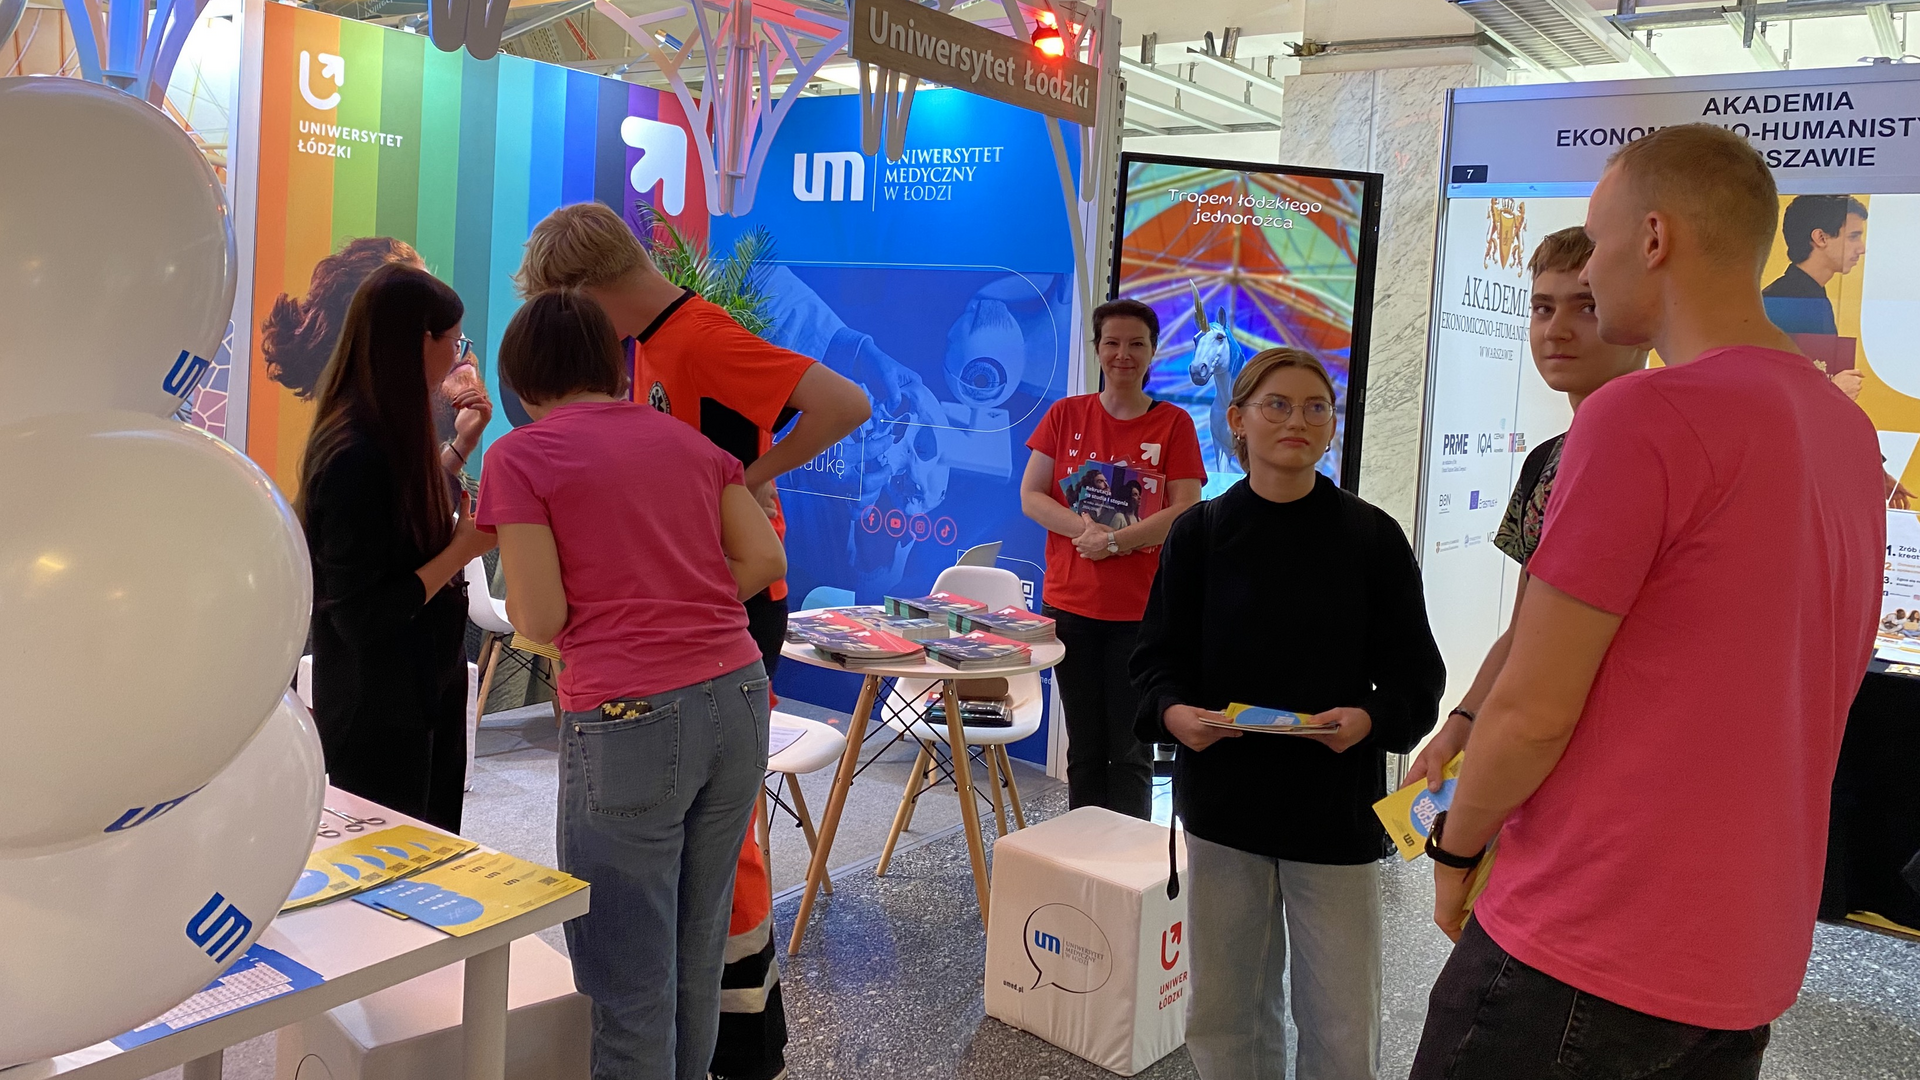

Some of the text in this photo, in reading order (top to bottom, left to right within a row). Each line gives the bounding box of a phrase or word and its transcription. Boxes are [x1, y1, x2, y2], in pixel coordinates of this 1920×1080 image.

[869, 7, 1090, 108] Uniwersytet Łódzki
[1702, 91, 1854, 116] AKADEMIA
[299, 120, 403, 148] UNIWERSYTET
[1556, 117, 1920, 147] EKONOO-HUMANIST
[297, 137, 351, 158] ŁÓDZKI
[885, 146, 1004, 165] UNIWERSYTET
[1757, 147, 1876, 168] SZAWIE
[884, 166, 976, 183] MEDYCZNY
[1467, 169, 1474, 180] 7
[884, 185, 952, 201] W ŁODZI
[1168, 188, 1322, 215] Tropem łódzkiego
[1193, 208, 1293, 229] jednorożca
[799, 458, 845, 480] aukę
[1160, 971, 1188, 996] UNIWER
[1159, 990, 1183, 1011] ŁÓDZKI
